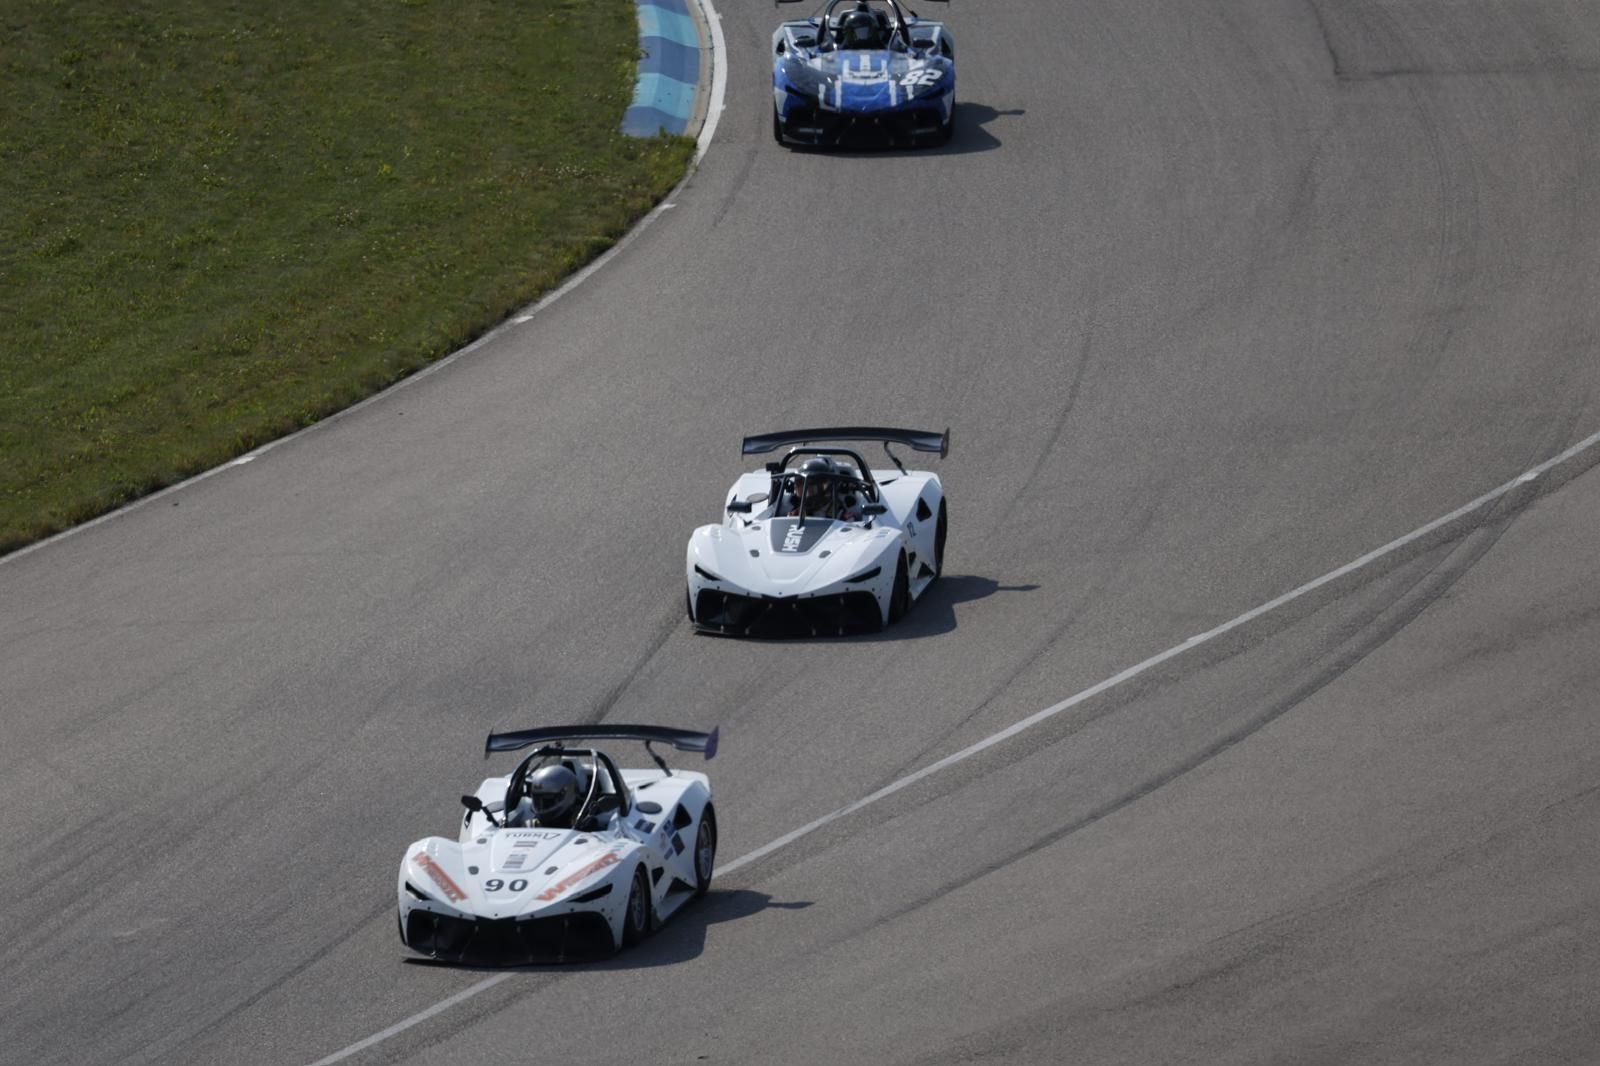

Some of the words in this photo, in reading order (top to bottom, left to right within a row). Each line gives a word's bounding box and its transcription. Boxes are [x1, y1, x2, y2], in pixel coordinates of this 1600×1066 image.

[900, 68, 943, 86] 82
[781, 524, 806, 552] RUSH
[484, 878, 529, 893] 90
